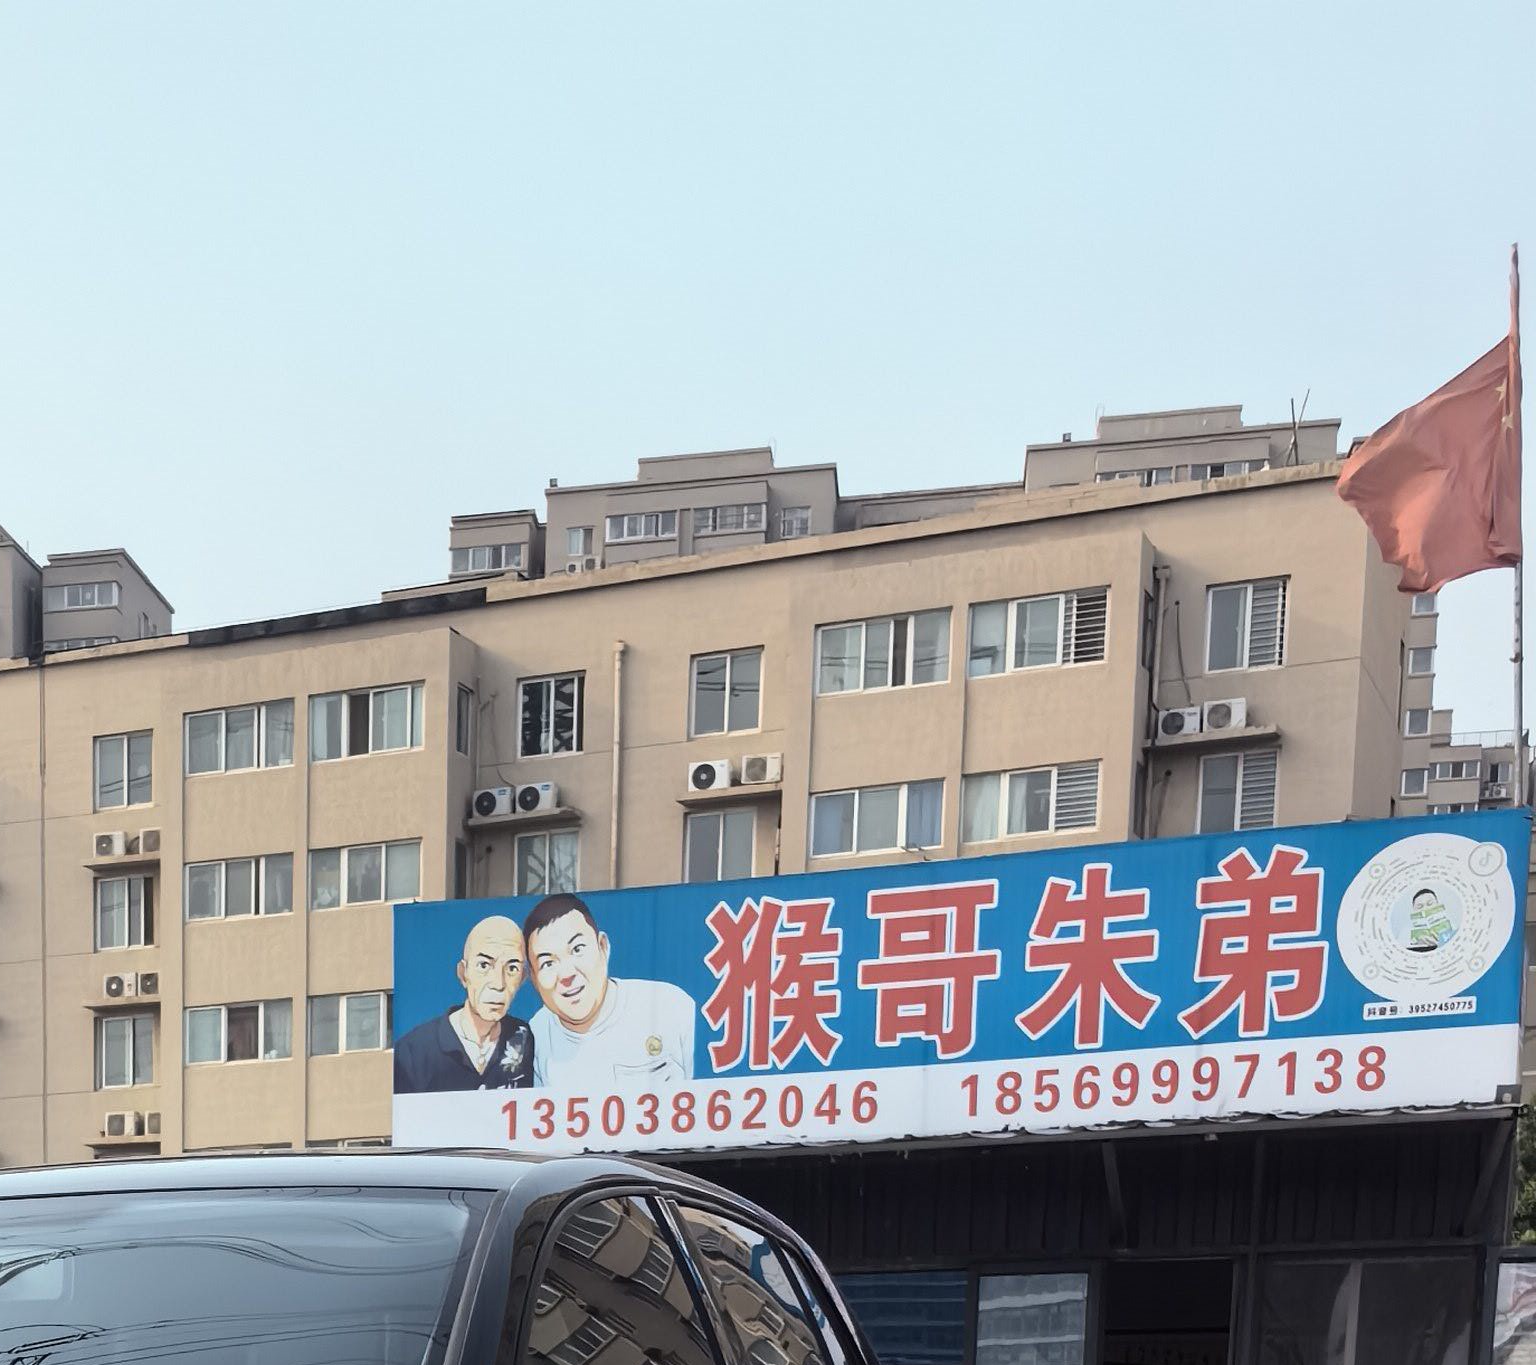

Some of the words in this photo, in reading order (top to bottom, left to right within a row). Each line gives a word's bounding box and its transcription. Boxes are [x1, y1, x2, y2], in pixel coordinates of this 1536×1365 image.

[700, 843, 1331, 1076] 猴哥朱弟
[1408, 1000, 1474, 1014] 39527450775
[500, 1080, 882, 1142] 13503862046
[960, 1043, 1389, 1117] 18569997138
